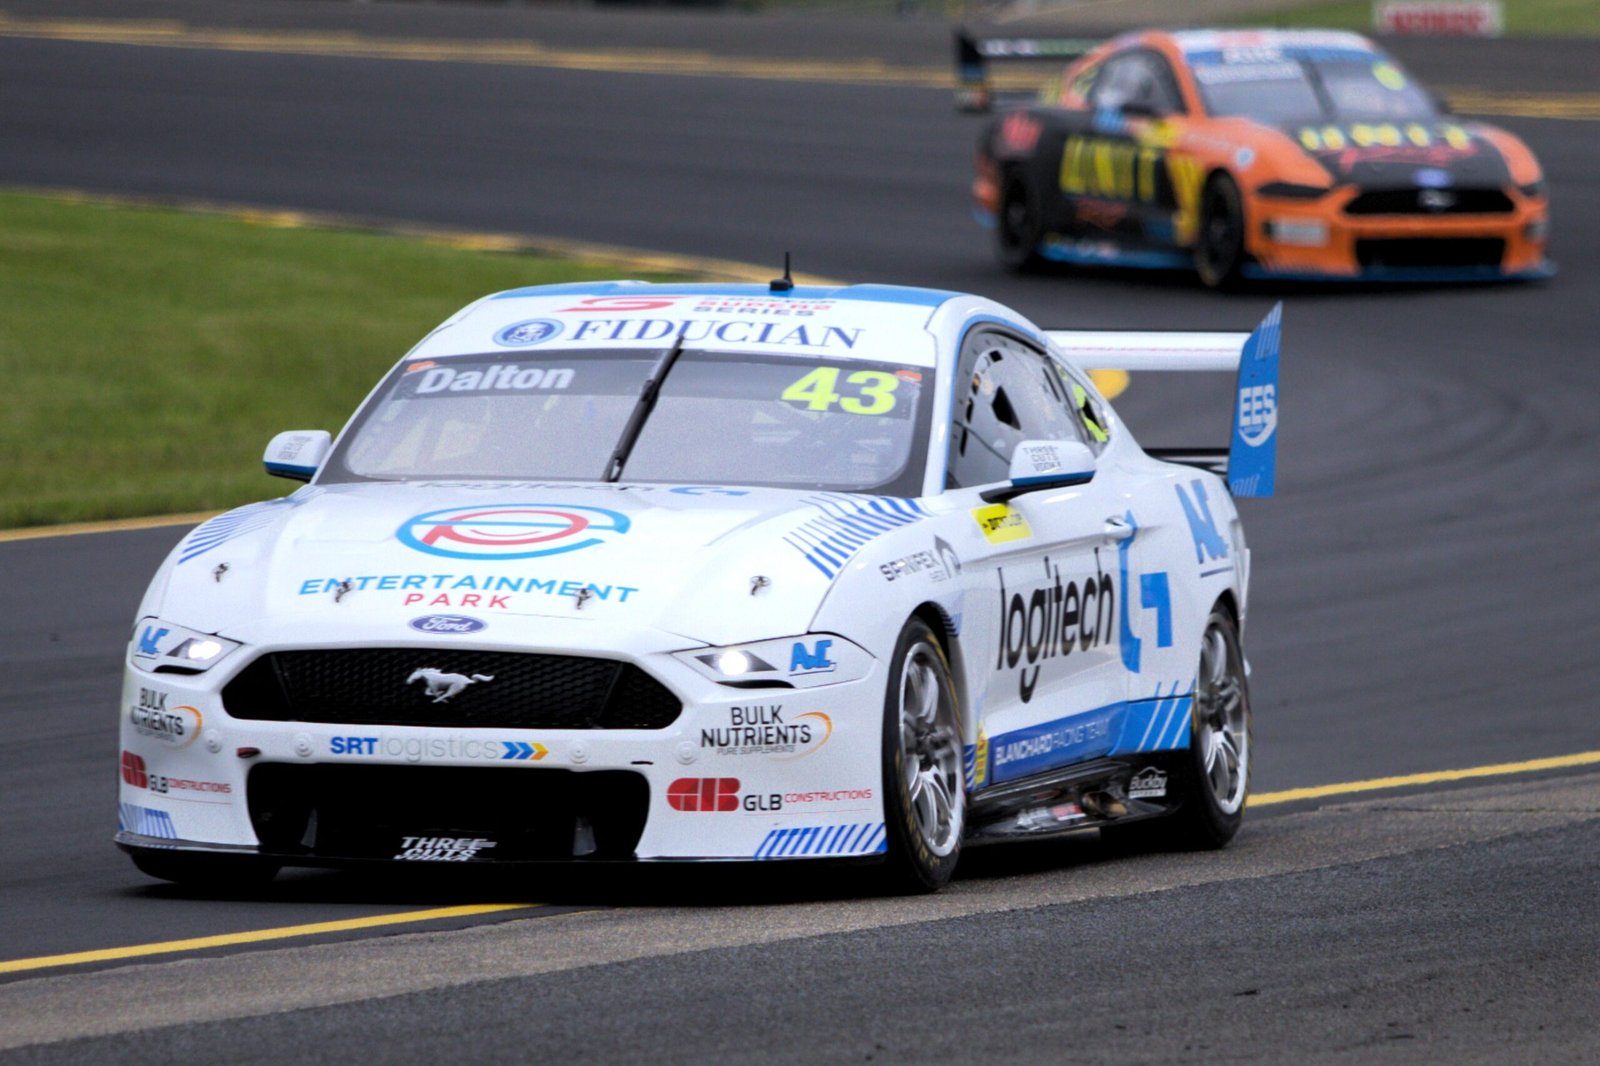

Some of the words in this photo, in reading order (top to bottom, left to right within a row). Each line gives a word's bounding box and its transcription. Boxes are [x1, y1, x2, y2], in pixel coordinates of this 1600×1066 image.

[693, 306, 815, 316] SERIES
[567, 319, 866, 349] FIDUCIAN
[416, 364, 575, 394] Dalton
[781, 367, 900, 416] 43
[299, 574, 640, 603] ENTERTAINMENT
[403, 593, 512, 609] PARK
[420, 616, 475, 633] Ford
[996, 546, 1115, 704] logitech
[730, 705, 784, 726] BULK
[700, 724, 812, 748] NUTRIENTS
[330, 736, 378, 755] SRT
[379, 734, 499, 763] logistics
[742, 794, 783, 812] GLB
[783, 789, 873, 804] CONSTRUCTIONS
[401, 836, 489, 850] THREE
